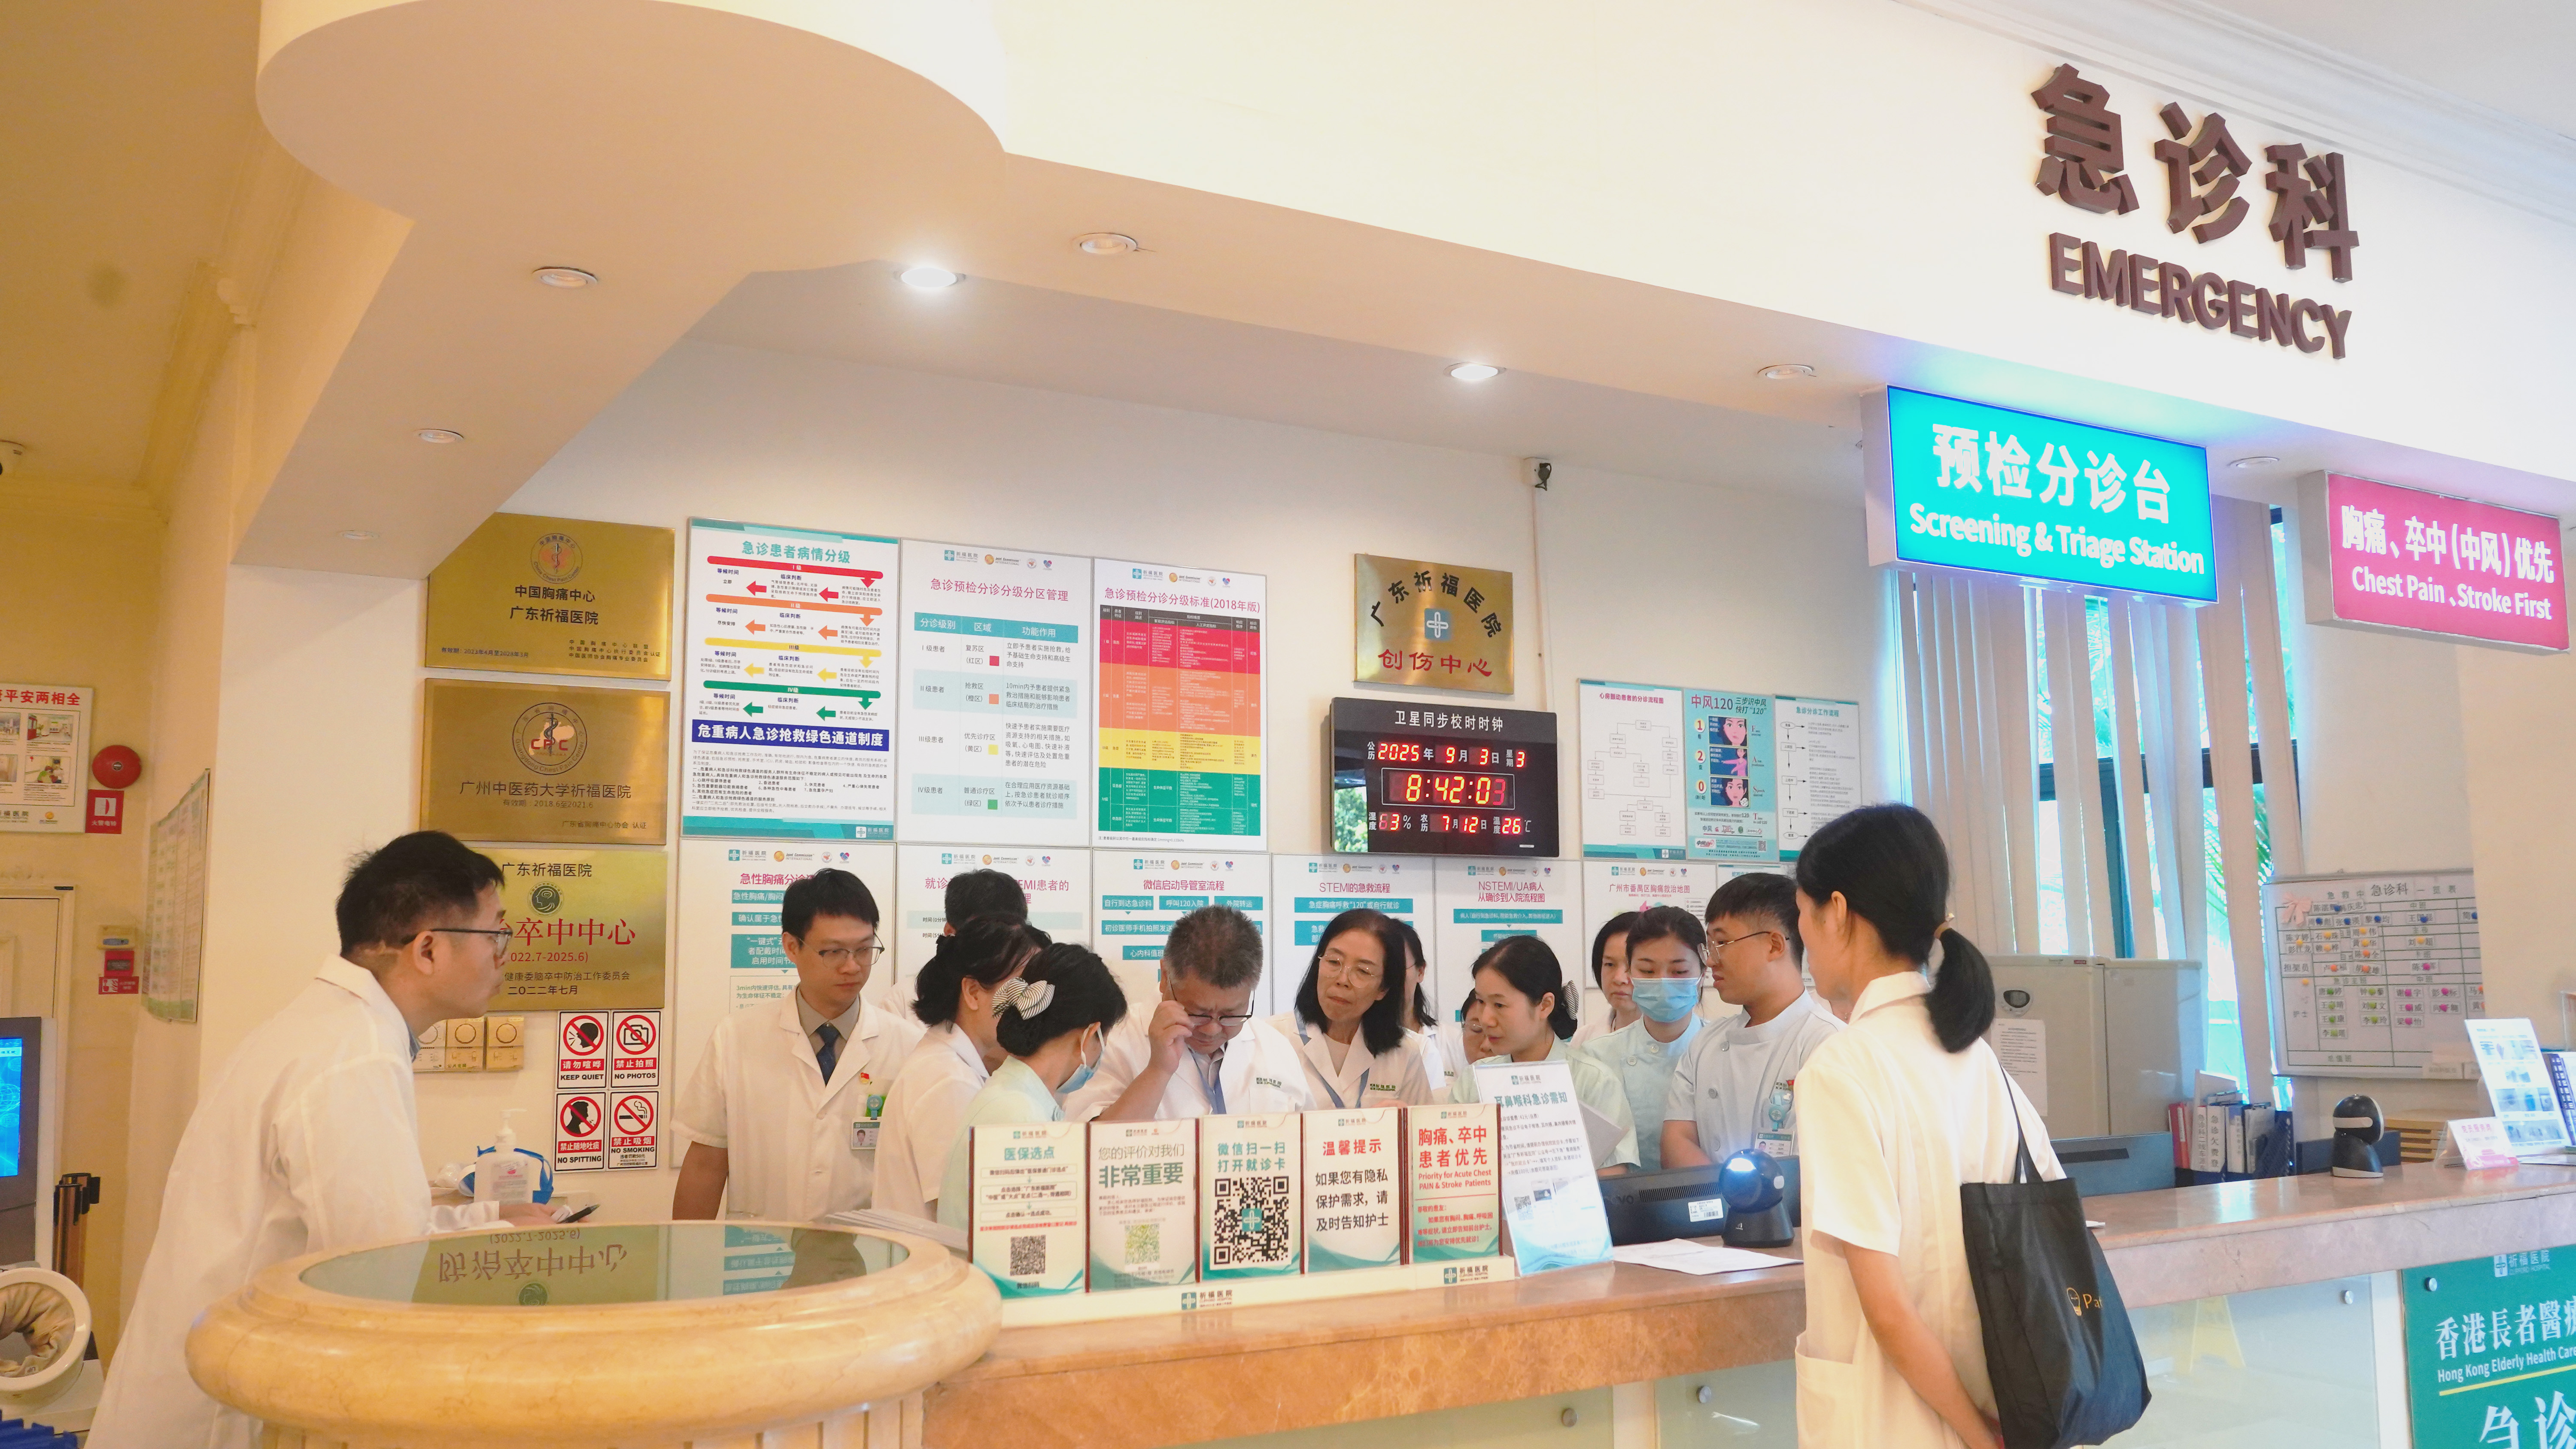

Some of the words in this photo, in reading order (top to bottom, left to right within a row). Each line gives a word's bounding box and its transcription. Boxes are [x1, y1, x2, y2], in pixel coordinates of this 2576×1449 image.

[2031, 64, 2359, 282] 急诊科
[2049, 232, 2352, 359] EMERGENCY
[1932, 424, 2171, 524] 预检分诊台
[1910, 503, 2032, 557] Screening
[2034, 522, 2053, 552] &
[2055, 525, 2125, 568] Triage
[2129, 536, 2204, 574] Station
[742, 540, 850, 564] 急诊患者病情分级
[515, 585, 595, 602] 中国胸痛中心
[931, 578, 1068, 601] 急诊预检分诊分级分区管理
[2352, 567, 2403, 597] Chest
[2407, 574, 2445, 602] Pain
[2515, 589, 2552, 619] First
[1370, 570, 1501, 638] 广东祈福医院
[510, 606, 598, 625] 广东祈福医院
[920, 618, 955, 629] 分诊级别
[974, 622, 991, 632] 区域
[1022, 627, 1056, 637] 功能作用
[1007, 652, 1070, 662] 予基础生命支持和高级生
[1378, 649, 1492, 677] 创伤中心
[1006, 692, 1070, 702] 救治措施和能够影响患者
[1692, 694, 1733, 709] 中风120
[1735, 697, 1766, 706] 三步识中风
[1006, 701, 1058, 710] 临床结局的治疗措施
[1735, 706, 1747, 714] 快打
[1005, 723, 1070, 732] 快速予患者实施需要医疗
[1395, 710, 1503, 732] 卫星同步校时时钟
[1698, 720, 1702, 730] 1
[698, 724, 883, 746] 危重病人急诊抢救绿色通道制度
[1378, 743, 1419, 762] 2025
[1424, 748, 1434, 760] 年
[1446, 747, 1455, 764] 9
[1458, 750, 1468, 762] 月
[1480, 749, 1488, 765] 3
[1492, 752, 1499, 764] 日
[1516, 751, 1525, 767] 3
[1698, 751, 1703, 761] 2
[459, 781, 631, 799] 广州中医药大学祈福医院
[1005, 782, 1070, 790] 在合理应用医疗资源基础
[1698, 781, 1704, 791] 0
[1005, 800, 1063, 809] 依次予以患者诊疗措施
[1442, 815, 1450, 831] 7
[1452, 819, 1458, 829] 月
[1463, 817, 1478, 833] 12
[1481, 819, 1487, 830] 日
[1502, 818, 1521, 834] 26
[501, 862, 592, 877] 广东祈福医院
[1143, 879, 1224, 891] 微信启动导管室流程
[1320, 883, 1390, 893] STEMI的急救流程
[1479, 881, 1544, 891] NSTEMI/UA病人
[1610, 884, 1690, 893] 广州市番禺区胸痛救治地图
[2371, 883, 2408, 897] 急诊科
[1478, 893, 1545, 902] 从确诊到入院流程图
[499, 918, 635, 946] 卒中中心
[507, 952, 589, 963] 022.7-2025.6)
[562, 1061, 601, 1070] 请勿喧哗
[616, 1060, 653, 1068] 禁止拍照
[1494, 1091, 1568, 1108] 耳鼻喉科急诊需知
[613, 1137, 652, 1146] 禁止吸烟
[1419, 1125, 1487, 1146] 胸痛、卒中
[560, 1142, 599, 1151] 禁止随地吐痰
[1004, 1146, 1054, 1161] 医保选点
[1099, 1144, 1184, 1160] 您的评价对我们
[1218, 1141, 1285, 1156] 微信扫一扫
[1323, 1139, 1381, 1156] 温馨提示
[1419, 1147, 1487, 1168] 患者优先
[1218, 1158, 1285, 1173] 打开就诊卡
[1099, 1162, 1183, 1188] 非常重要
[1315, 1168, 1388, 1186] 如果您有隐私
[1419, 1172, 1442, 1180] Priority
[1316, 1213, 1388, 1232] 及时告知护士
[2509, 1249, 2549, 1267] 祈福医院
[2438, 1370, 2463, 1383] Hong
[2466, 1364, 2490, 1377] Kong
[2492, 1355, 2524, 1372] Elderly
[2527, 1348, 2556, 1366] Health
